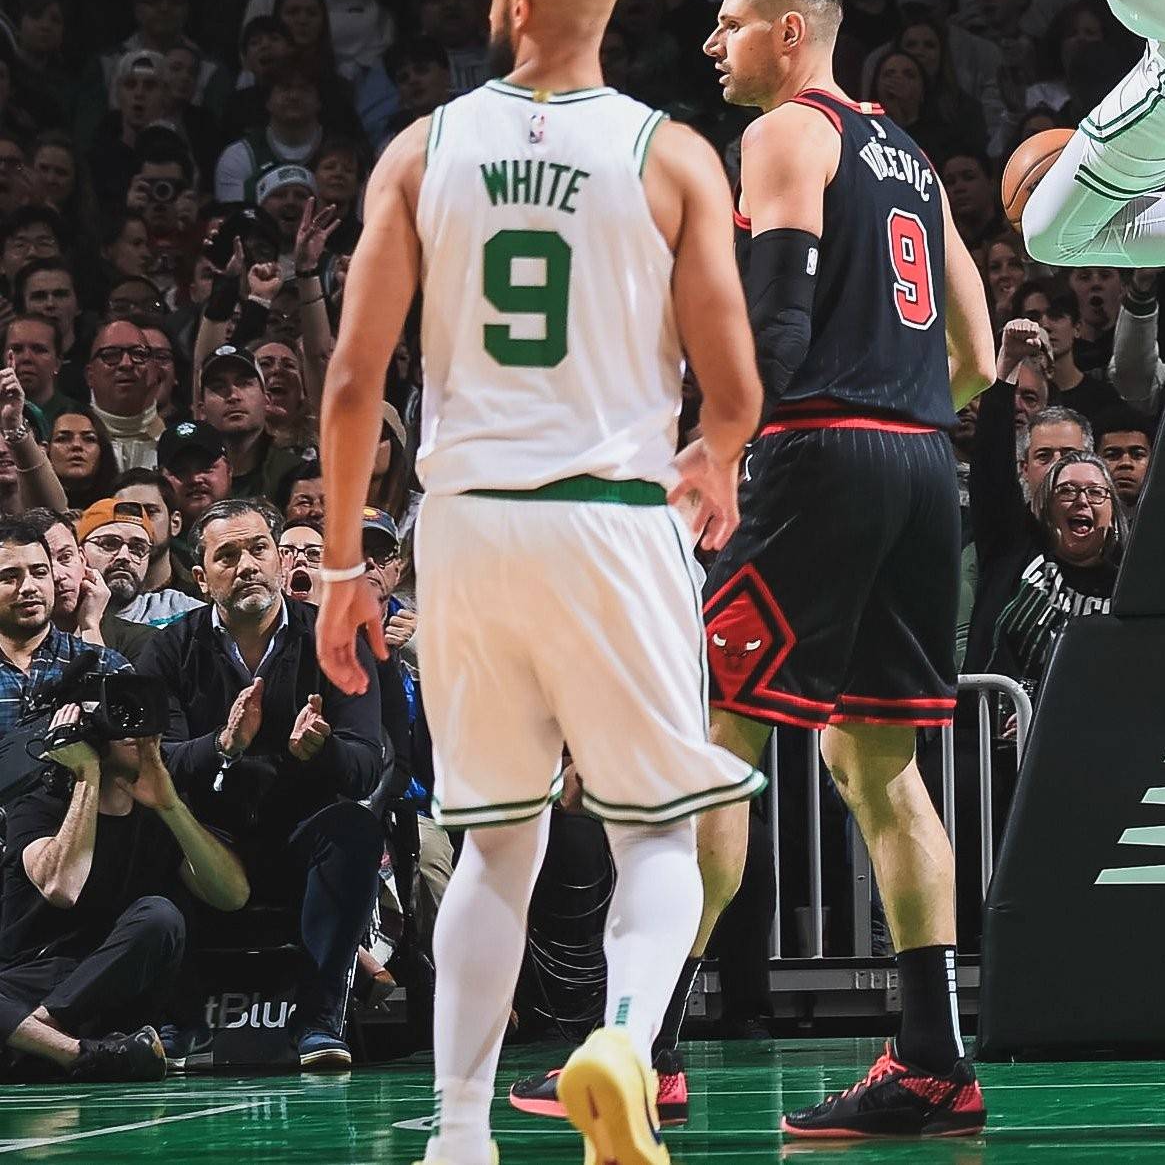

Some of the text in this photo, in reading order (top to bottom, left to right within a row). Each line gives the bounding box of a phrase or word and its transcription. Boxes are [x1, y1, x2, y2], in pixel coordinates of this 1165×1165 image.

[480, 159, 591, 215] WHITE
[482, 229, 572, 368] 9
[887, 207, 938, 331] 9
